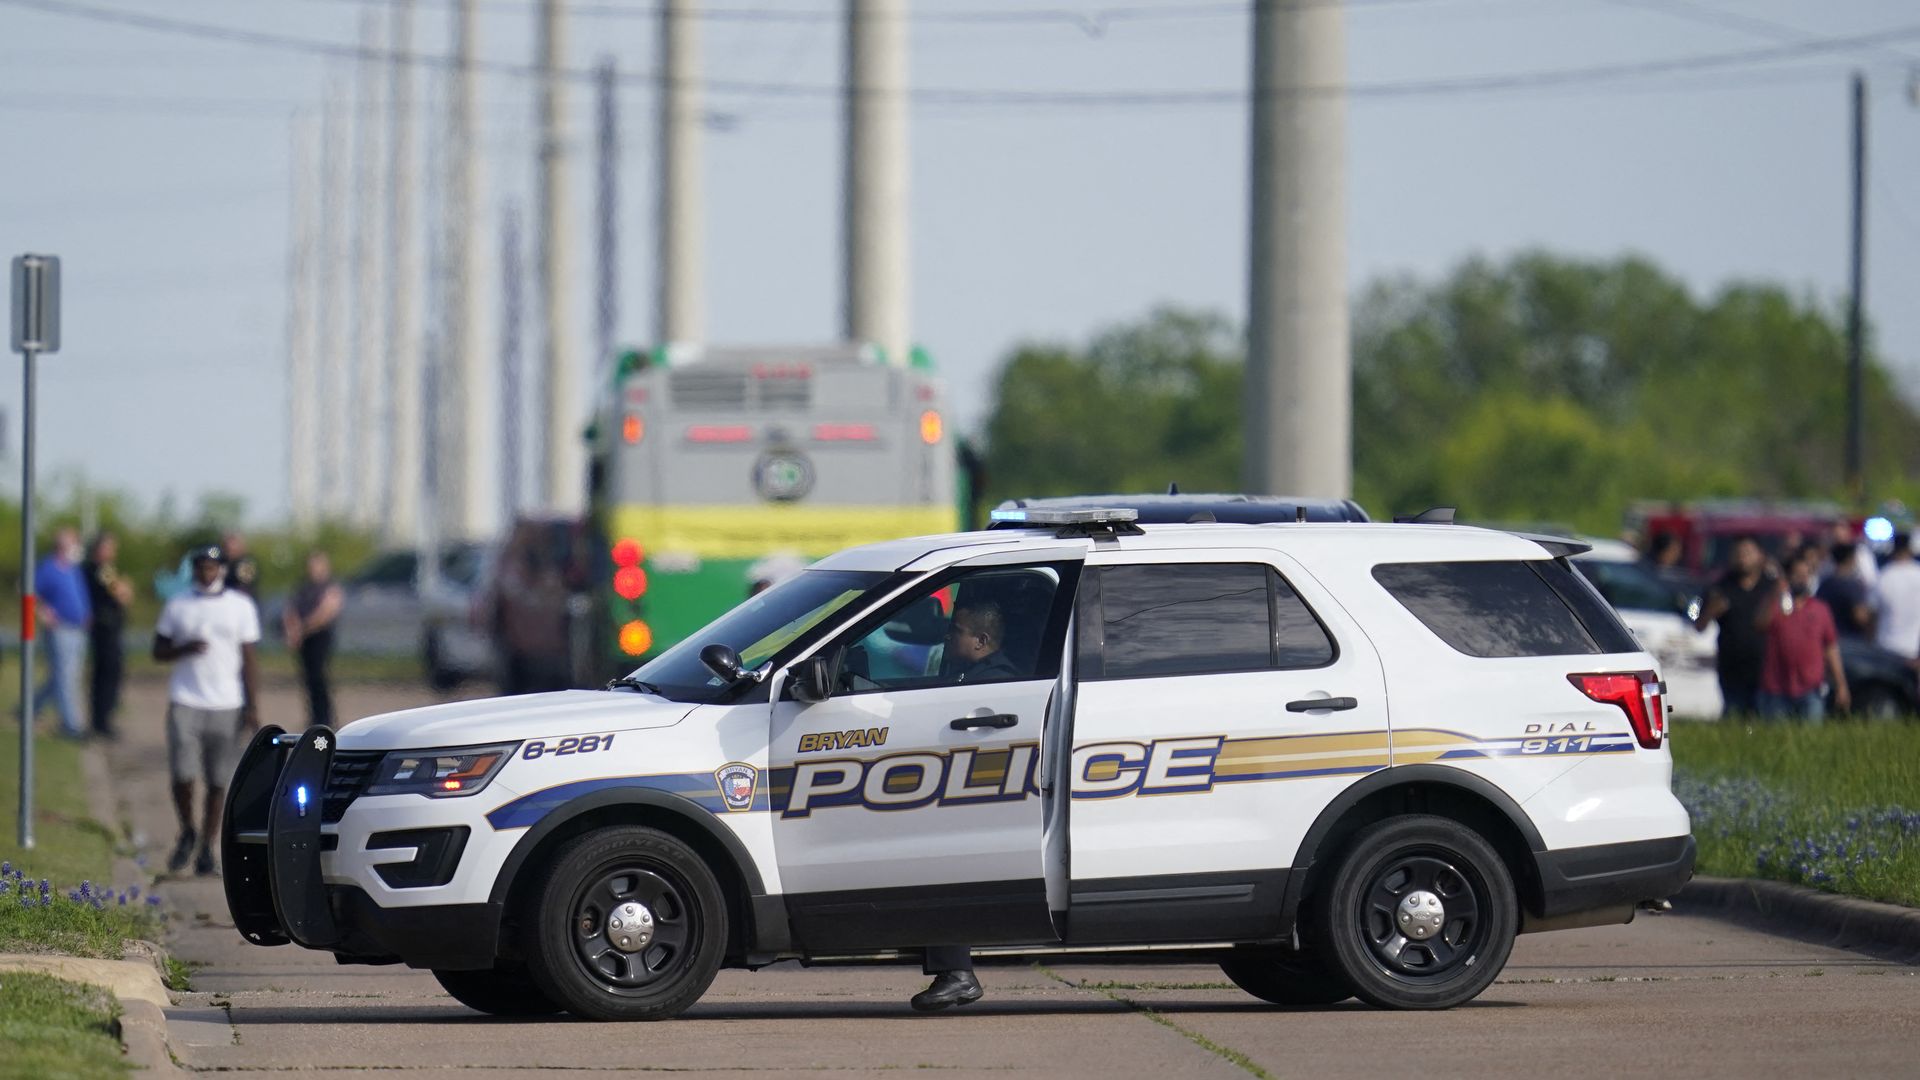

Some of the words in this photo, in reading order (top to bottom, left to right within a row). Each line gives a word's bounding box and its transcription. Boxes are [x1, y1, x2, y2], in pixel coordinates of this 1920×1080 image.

[797, 727, 889, 753] BRYAN
[1525, 722, 1597, 734] DIAL
[522, 733, 616, 761] 6-281
[782, 737, 1226, 818] POLICE
